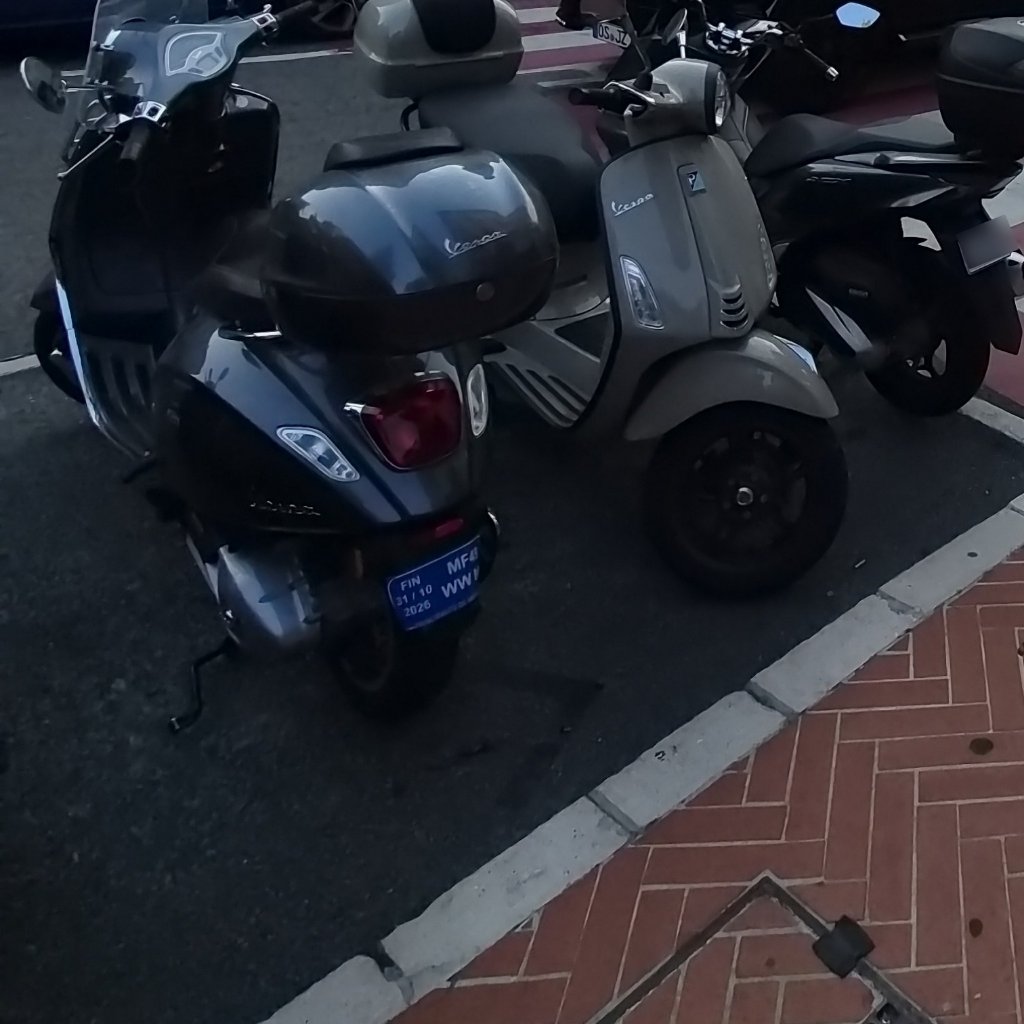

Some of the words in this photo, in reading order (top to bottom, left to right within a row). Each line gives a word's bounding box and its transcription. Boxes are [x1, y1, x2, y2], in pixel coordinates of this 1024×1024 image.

[611, 193, 654, 217] Vespa
[444, 231, 508, 259] Vespa
[400, 575, 421, 592] FIN
[418, 584, 432, 597] 10
[403, 599, 431, 617] 2026
